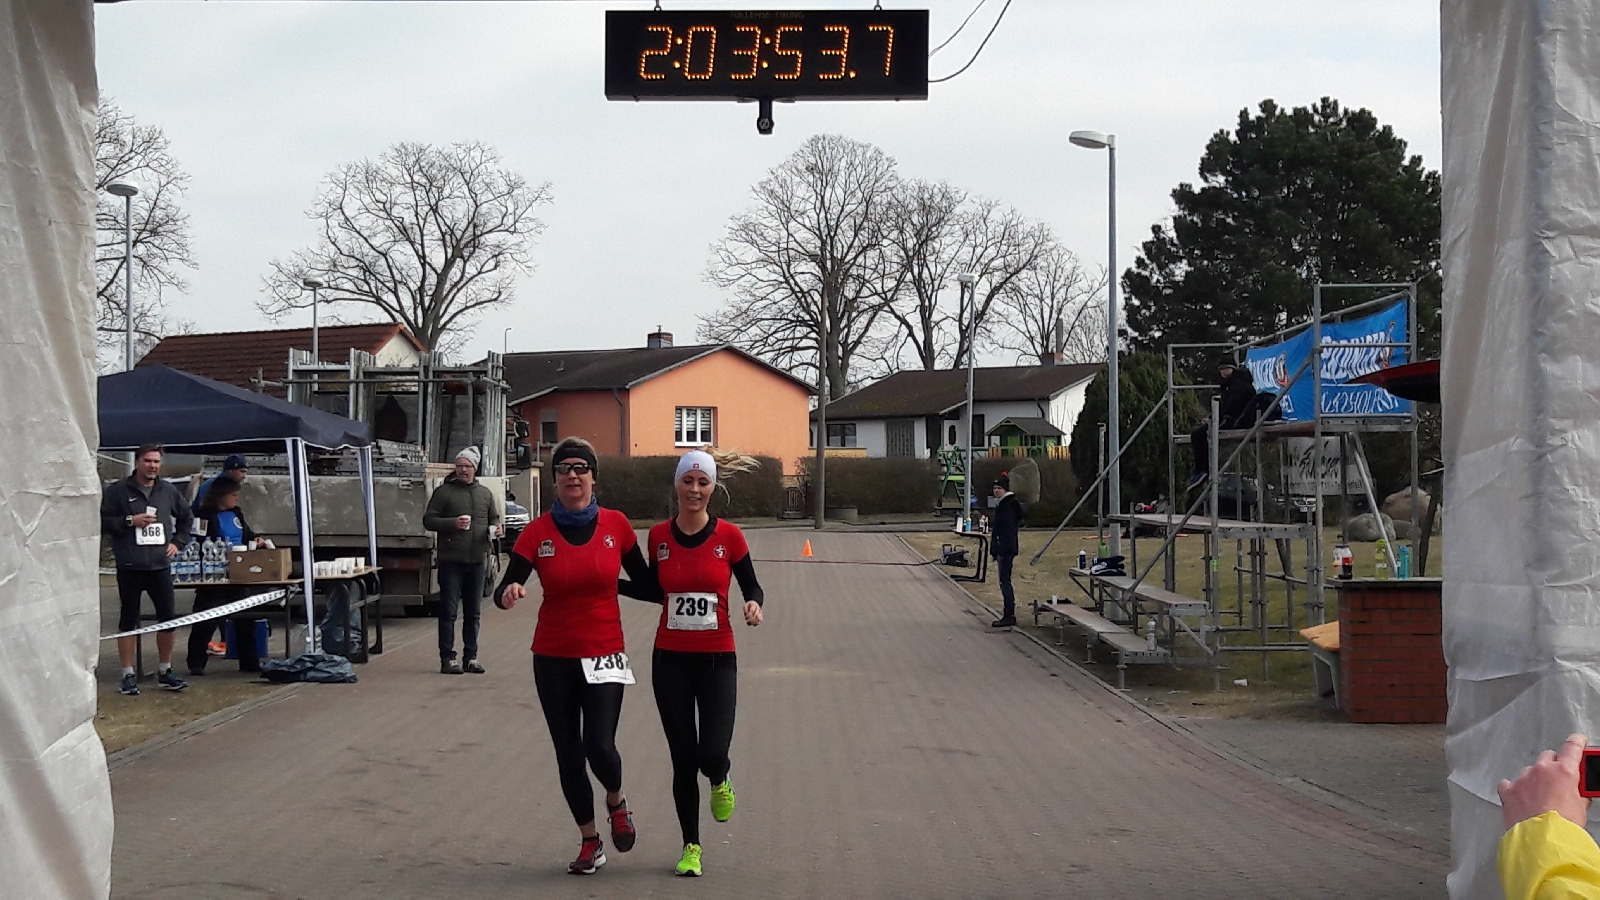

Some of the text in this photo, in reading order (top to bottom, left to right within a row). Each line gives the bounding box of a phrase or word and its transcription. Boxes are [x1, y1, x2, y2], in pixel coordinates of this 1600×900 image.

[142, 526, 161, 537] 868
[675, 596, 709, 617] 239
[591, 653, 624, 671] 238
